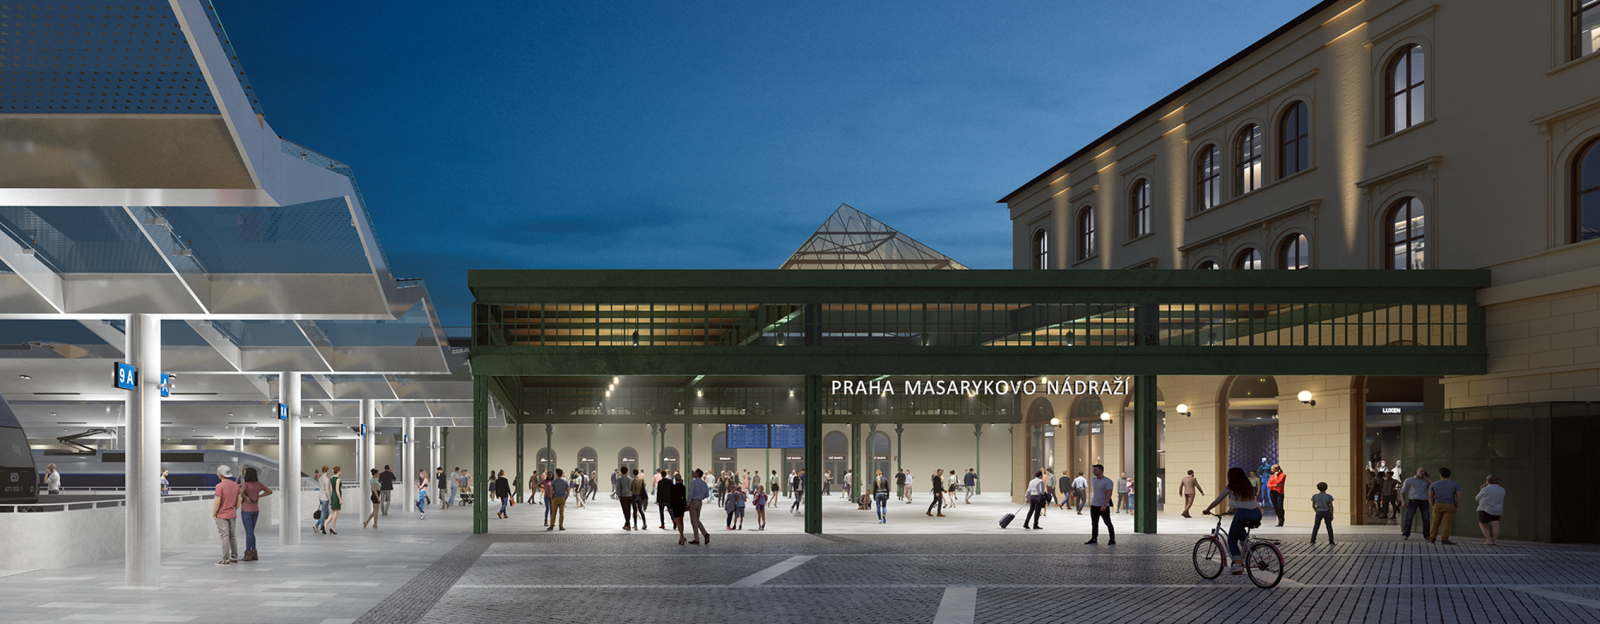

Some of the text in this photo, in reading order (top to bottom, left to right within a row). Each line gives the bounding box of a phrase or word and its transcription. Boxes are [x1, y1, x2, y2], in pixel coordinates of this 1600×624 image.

[120, 368, 134, 385] 9 A
[832, 376, 1131, 395] PRAHA MASARYKOVO NÁDRAŽÍ
